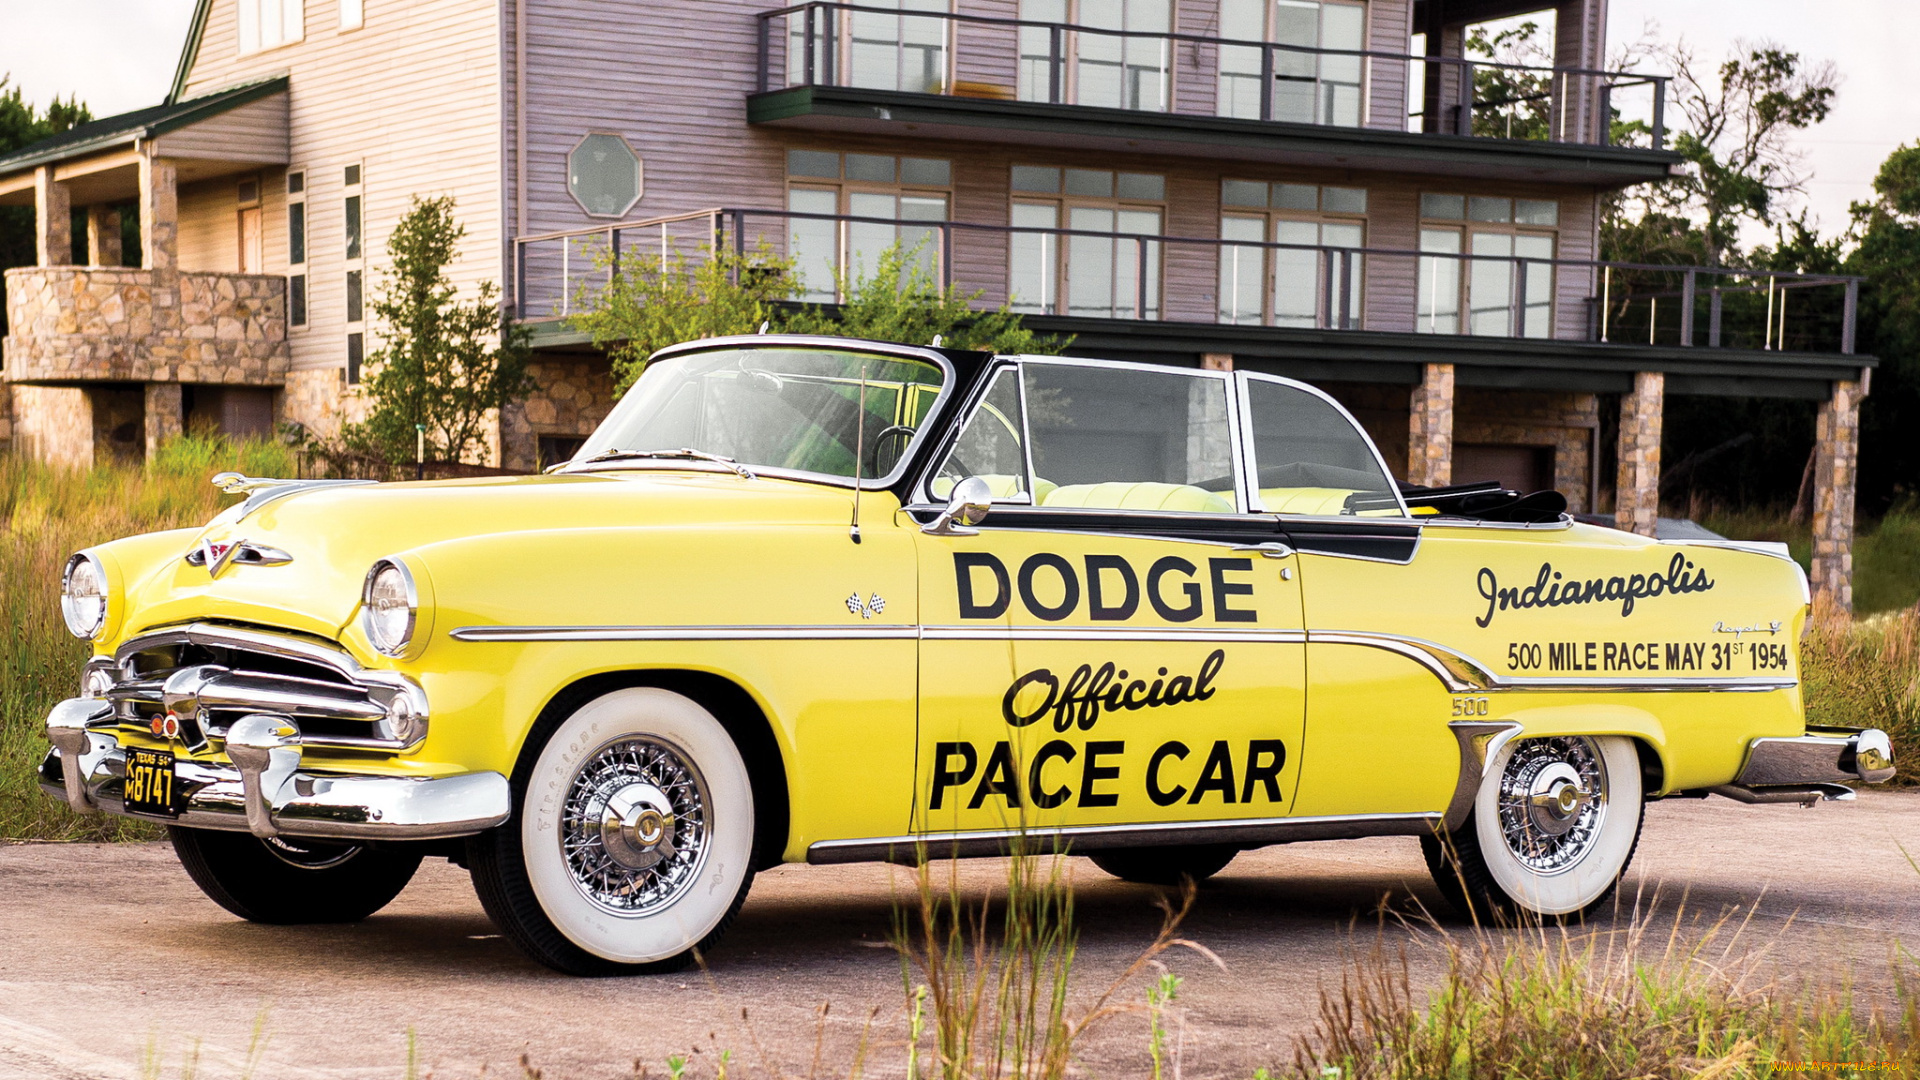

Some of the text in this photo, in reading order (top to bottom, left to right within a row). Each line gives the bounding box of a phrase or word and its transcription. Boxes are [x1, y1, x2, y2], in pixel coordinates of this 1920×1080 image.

[953, 552, 1257, 622] DODGE
[1475, 552, 1714, 628] Indianapolis
[1507, 643, 1542, 670] 500
[1549, 643, 1597, 671] MILE
[1603, 643, 1659, 671] RACE
[1665, 643, 1706, 671] MAY
[1749, 643, 1788, 671] 1954
[1002, 649, 1225, 733] Official
[1452, 697, 1489, 716] 500
[136, 752, 156, 764] TEXAS
[929, 739, 1286, 810] PACE CAR
[134, 766, 172, 806] 8747
